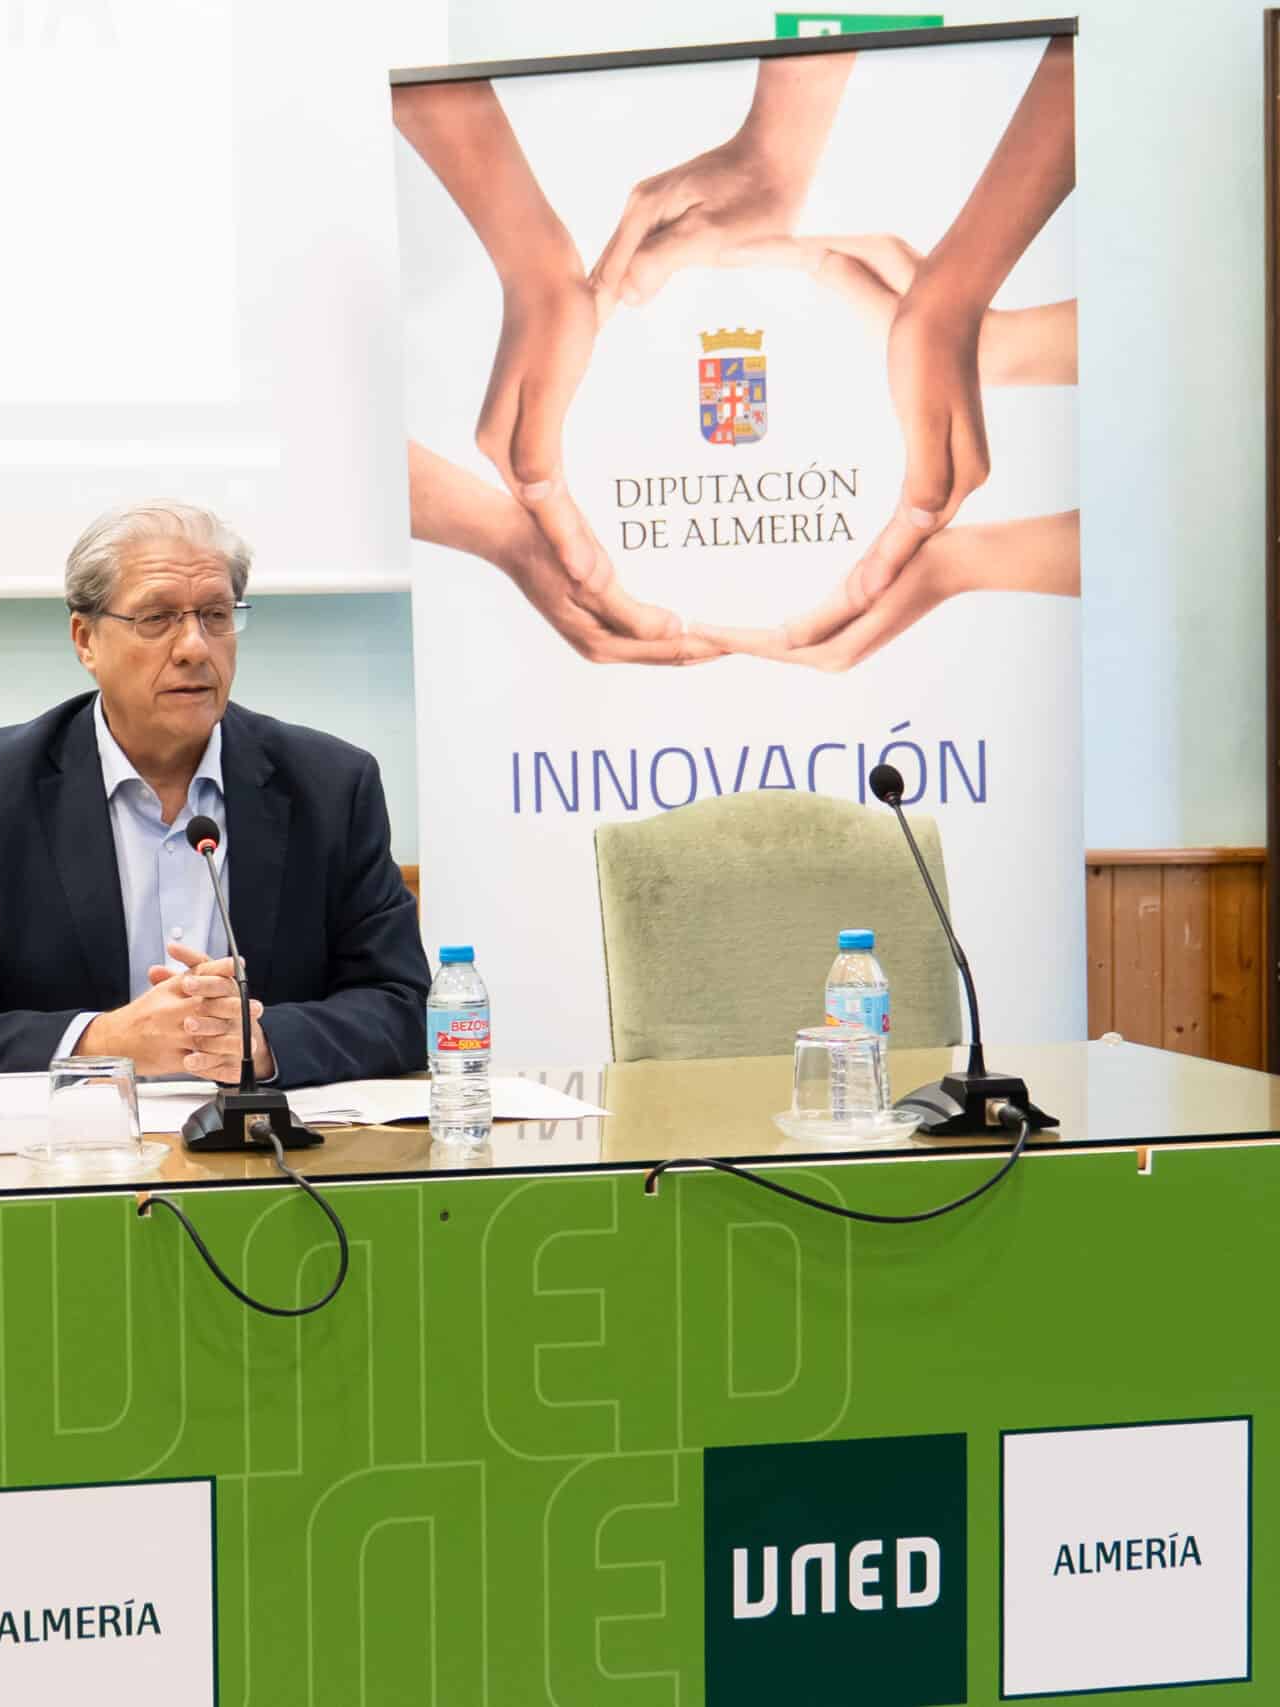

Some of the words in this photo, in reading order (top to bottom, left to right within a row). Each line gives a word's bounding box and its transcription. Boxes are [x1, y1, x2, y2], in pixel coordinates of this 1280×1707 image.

[614, 461, 860, 508] DIPUTACIÓN
[620, 520, 669, 550] DE
[682, 504, 855, 547] ALMERÍA
[512, 720, 987, 814] INNOVACIÓN
[1052, 1532, 1202, 1576] ALMERÍA
[732, 1536, 941, 1620] UNED
